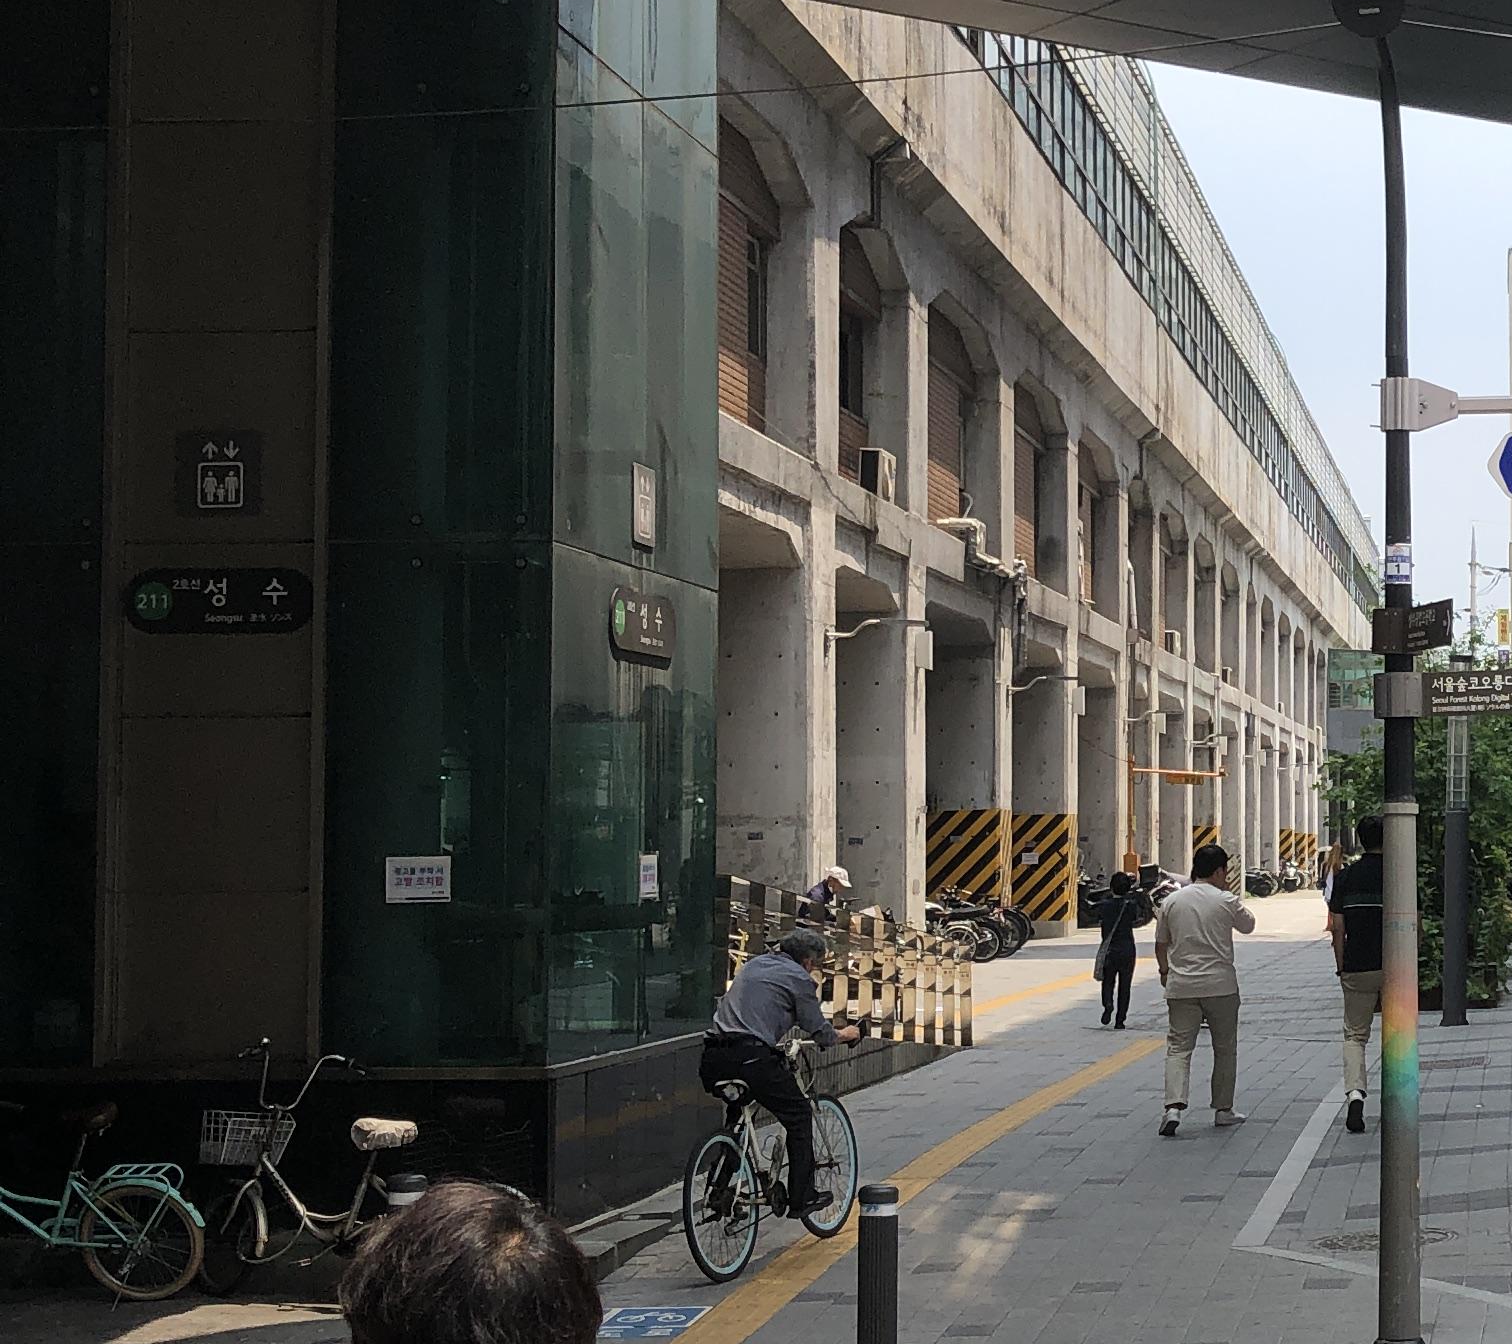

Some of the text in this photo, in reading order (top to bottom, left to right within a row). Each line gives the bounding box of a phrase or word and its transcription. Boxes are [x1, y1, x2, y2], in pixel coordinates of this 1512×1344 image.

[136, 593, 168, 609] 211
[172, 578, 201, 590] 2호선
[204, 612, 243, 624] Seongsu
